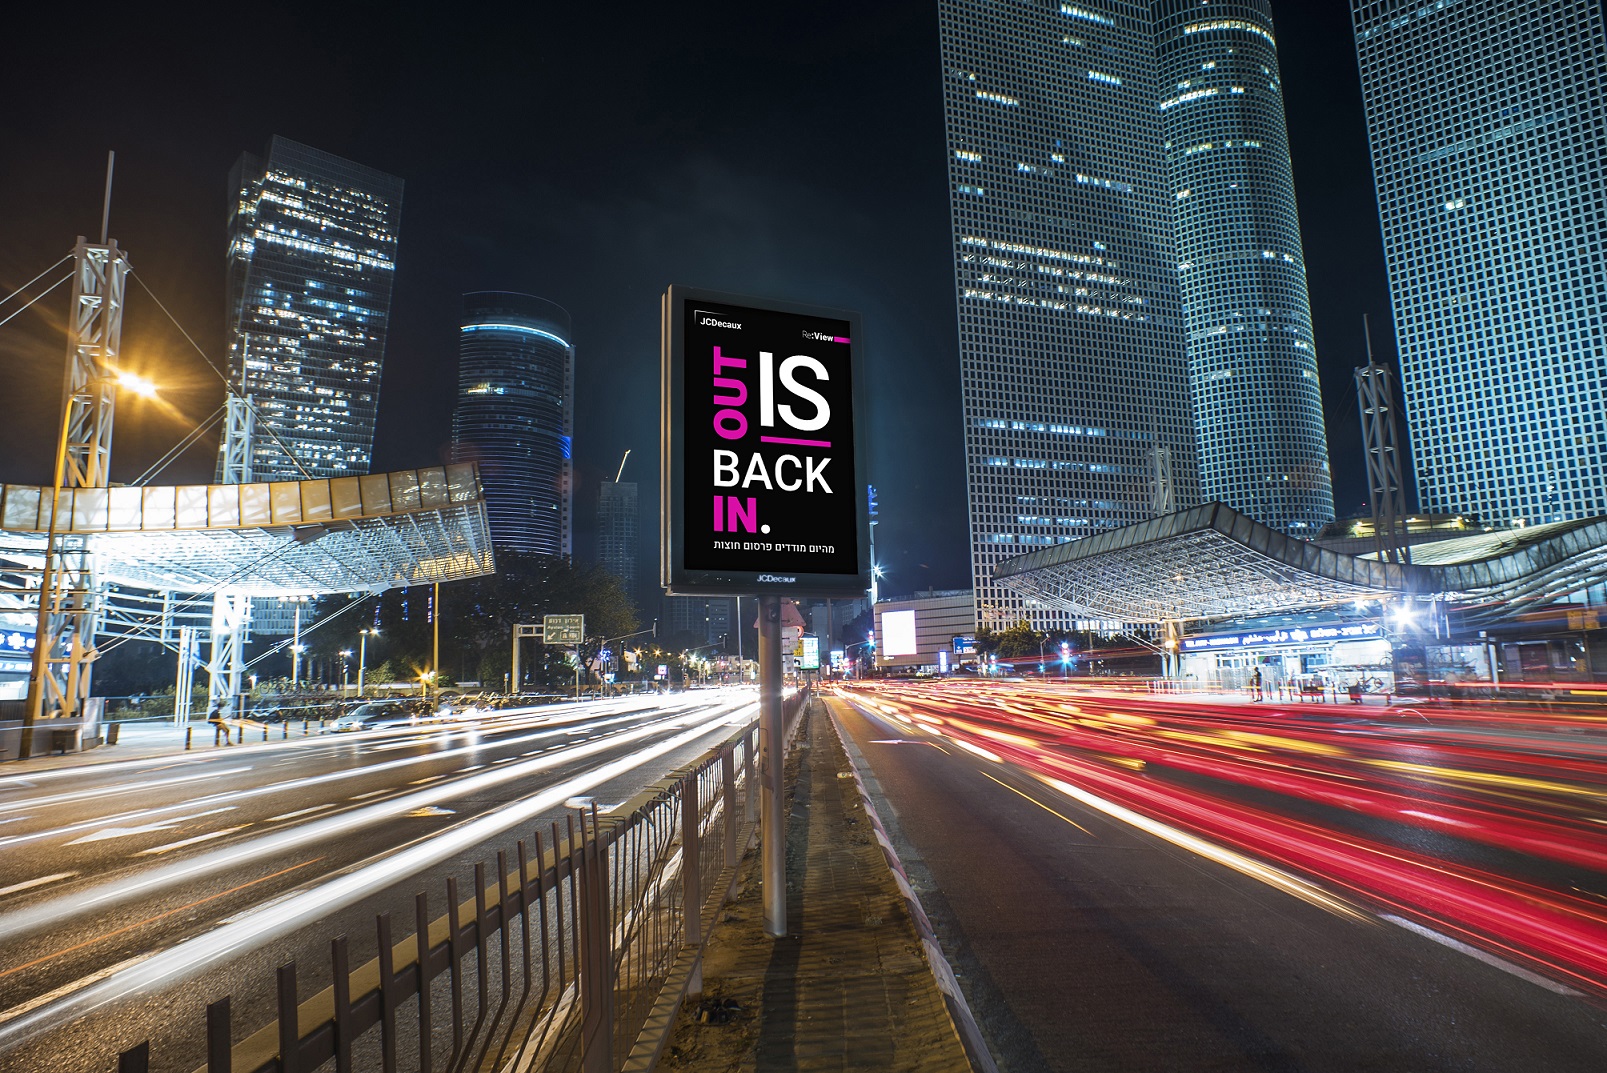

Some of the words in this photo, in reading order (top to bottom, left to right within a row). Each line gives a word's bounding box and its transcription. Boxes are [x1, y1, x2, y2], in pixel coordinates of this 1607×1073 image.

[700, 317, 742, 330] JCDecaux
[802, 330, 834, 342] Re:View
[713, 346, 748, 440] OUT
[759, 351, 831, 431] IS
[713, 449, 833, 494] BACK
[713, 495, 771, 534] IN.
[713, 541, 741, 550] חוצות
[743, 542, 773, 551] פרסום
[775, 543, 807, 553] מודדים
[809, 545, 835, 554] מהיום
[757, 574, 796, 583] JCDecaux
